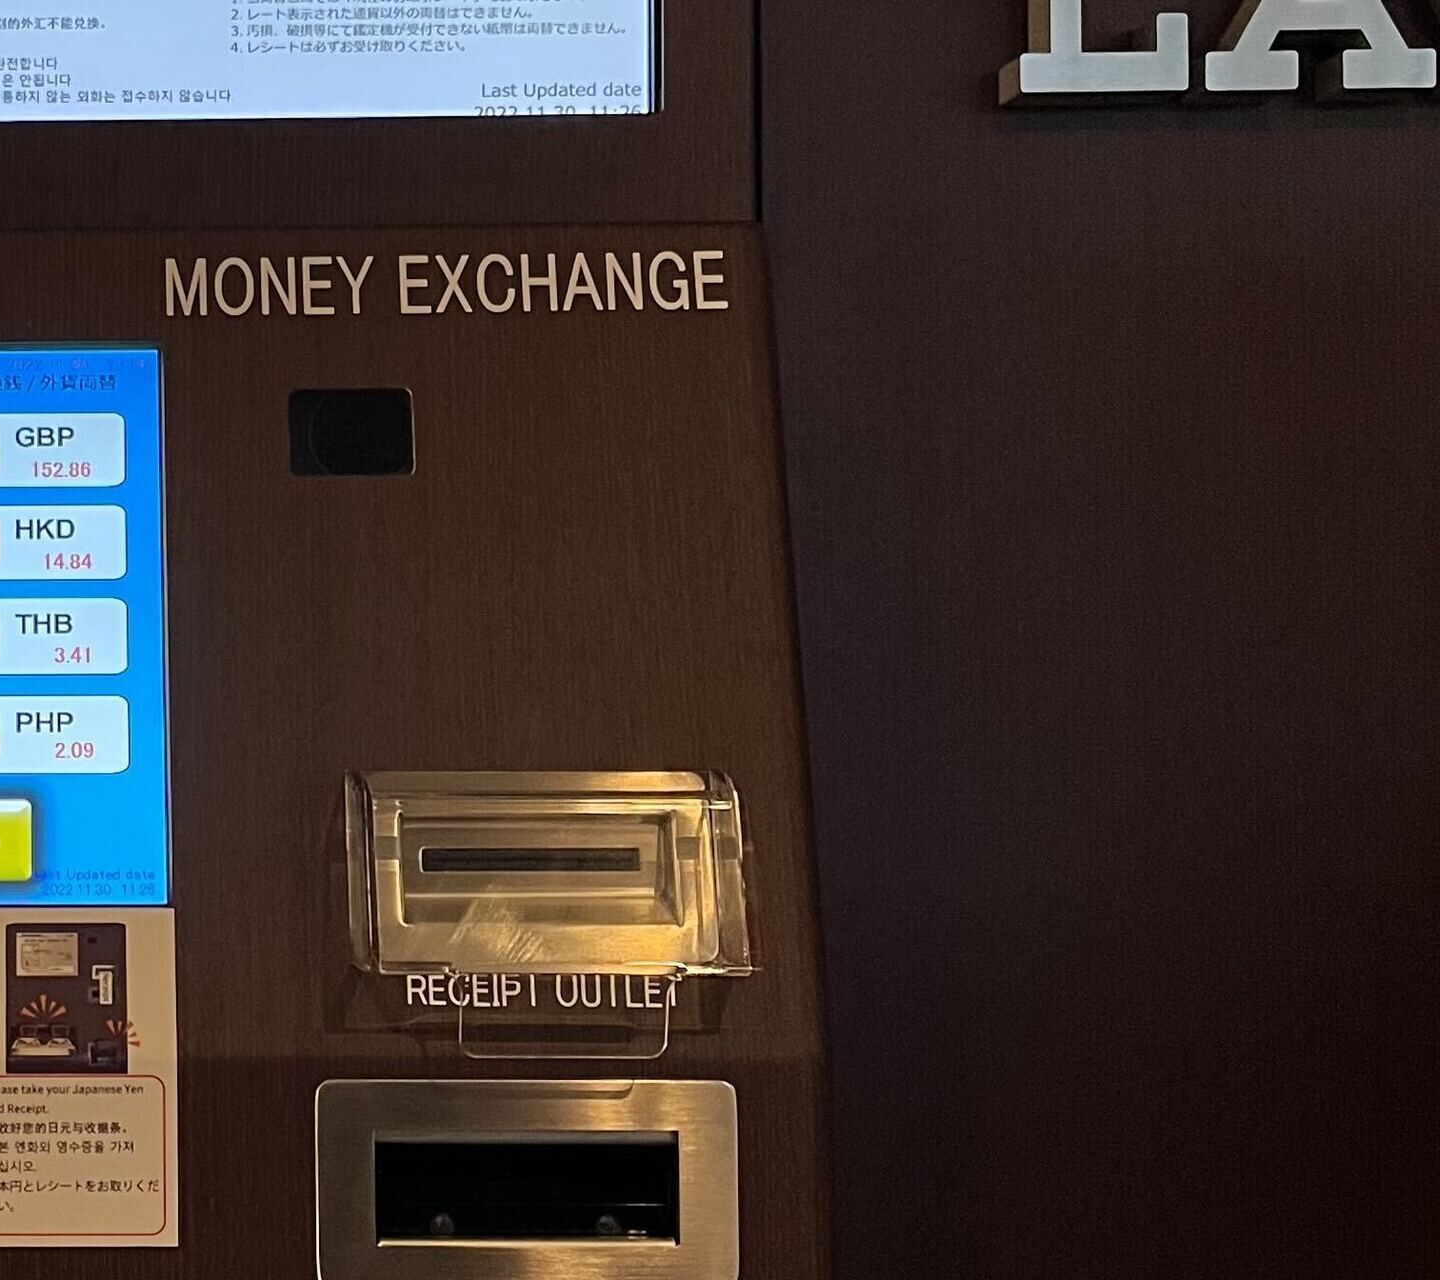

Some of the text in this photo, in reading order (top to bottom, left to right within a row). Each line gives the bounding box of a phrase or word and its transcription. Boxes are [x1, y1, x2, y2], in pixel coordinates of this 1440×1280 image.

[247, 39, 466, 54] レシートは必ずお受け取りください。
[481, 82, 642, 100] Last Updated date
[164, 250, 730, 317] MONEY EXCHANGE
[15, 426, 75, 448] GBP
[32, 461, 92, 479] 152.86
[16, 518, 76, 540] HKD
[45, 553, 93, 570] 14.84
[15, 613, 74, 635] THB
[54, 647, 92, 664] 3.41
[16, 712, 75, 734] PHP
[55, 742, 95, 759] 2.09
[21, 1084, 44, 1096] take
[47, 1084, 70, 1096] your
[72, 1084, 122, 1096] Japanese
[125, 1084, 144, 1096] Yen
[8, 1104, 49, 1115] Receipt.
